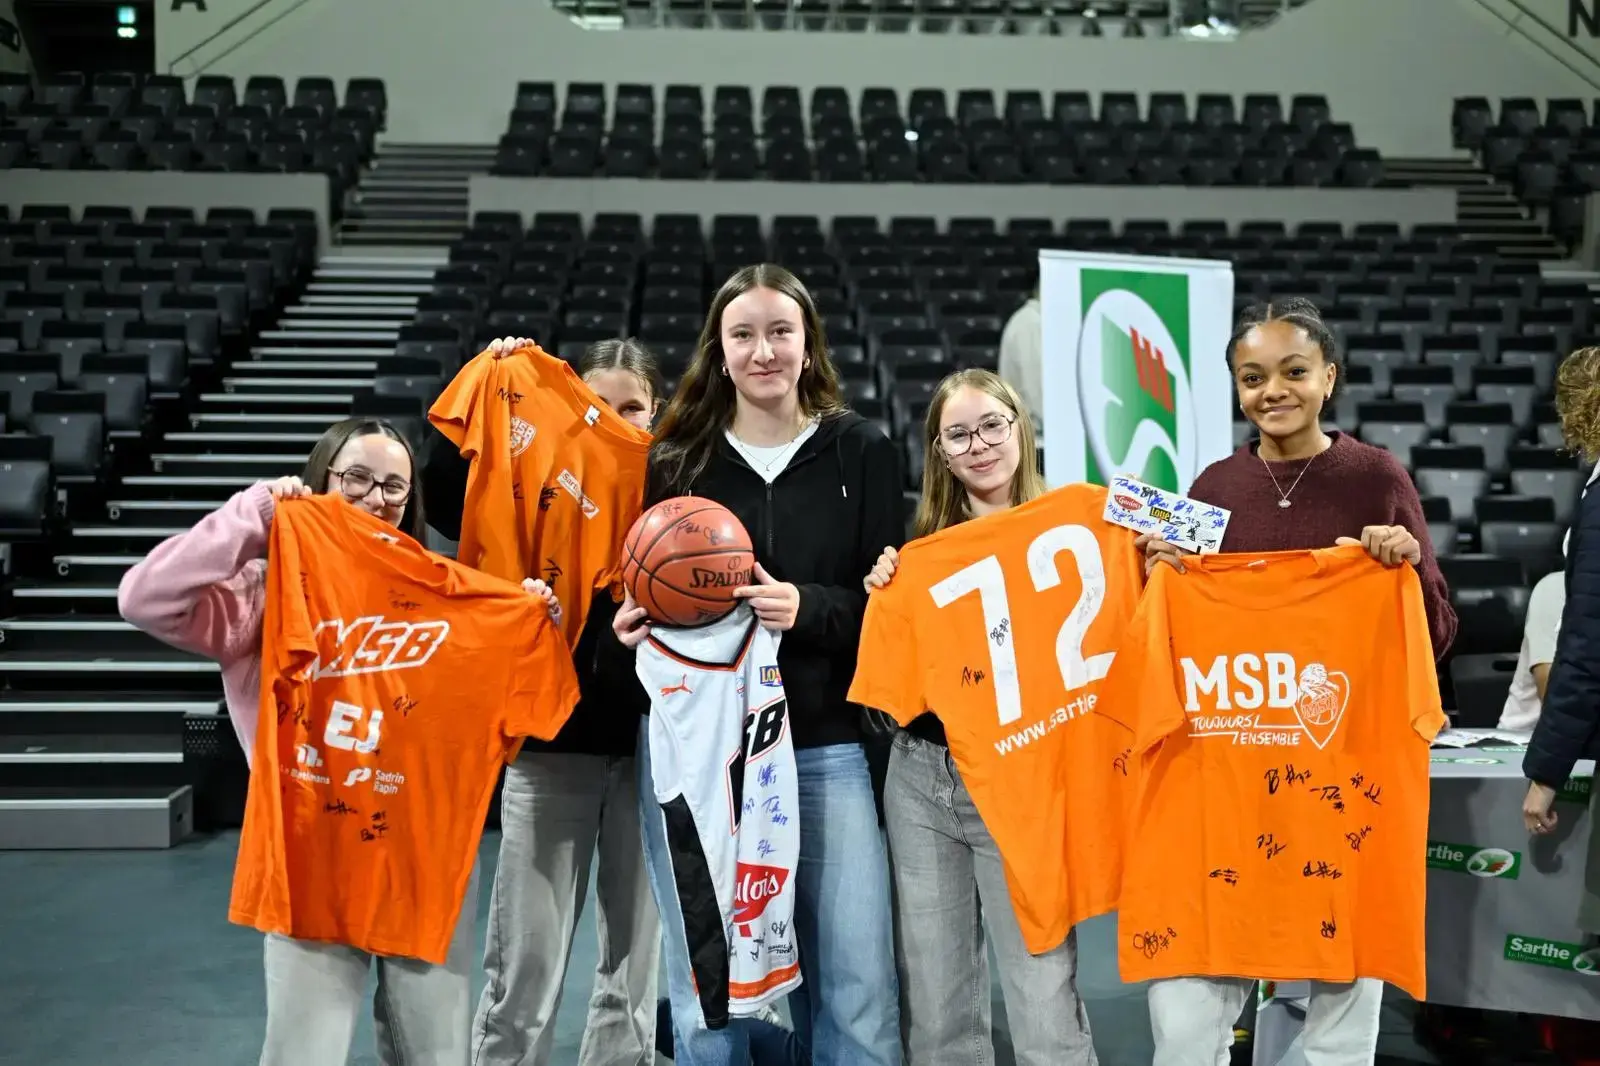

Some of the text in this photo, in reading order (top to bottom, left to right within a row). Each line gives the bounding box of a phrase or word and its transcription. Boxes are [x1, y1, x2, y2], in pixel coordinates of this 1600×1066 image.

[928, 524, 1117, 726] 72
[303, 616, 450, 681] MSB
[1180, 652, 1298, 712] MSB
[324, 700, 384, 754] EJ
[1190, 713, 1253, 731] TOUJOURS
[1239, 731, 1302, 746] ENSEMBLE
[375, 769, 405, 785] Sadrin
[1427, 845, 1464, 861] rthe
[1510, 937, 1570, 960] Sarthe
